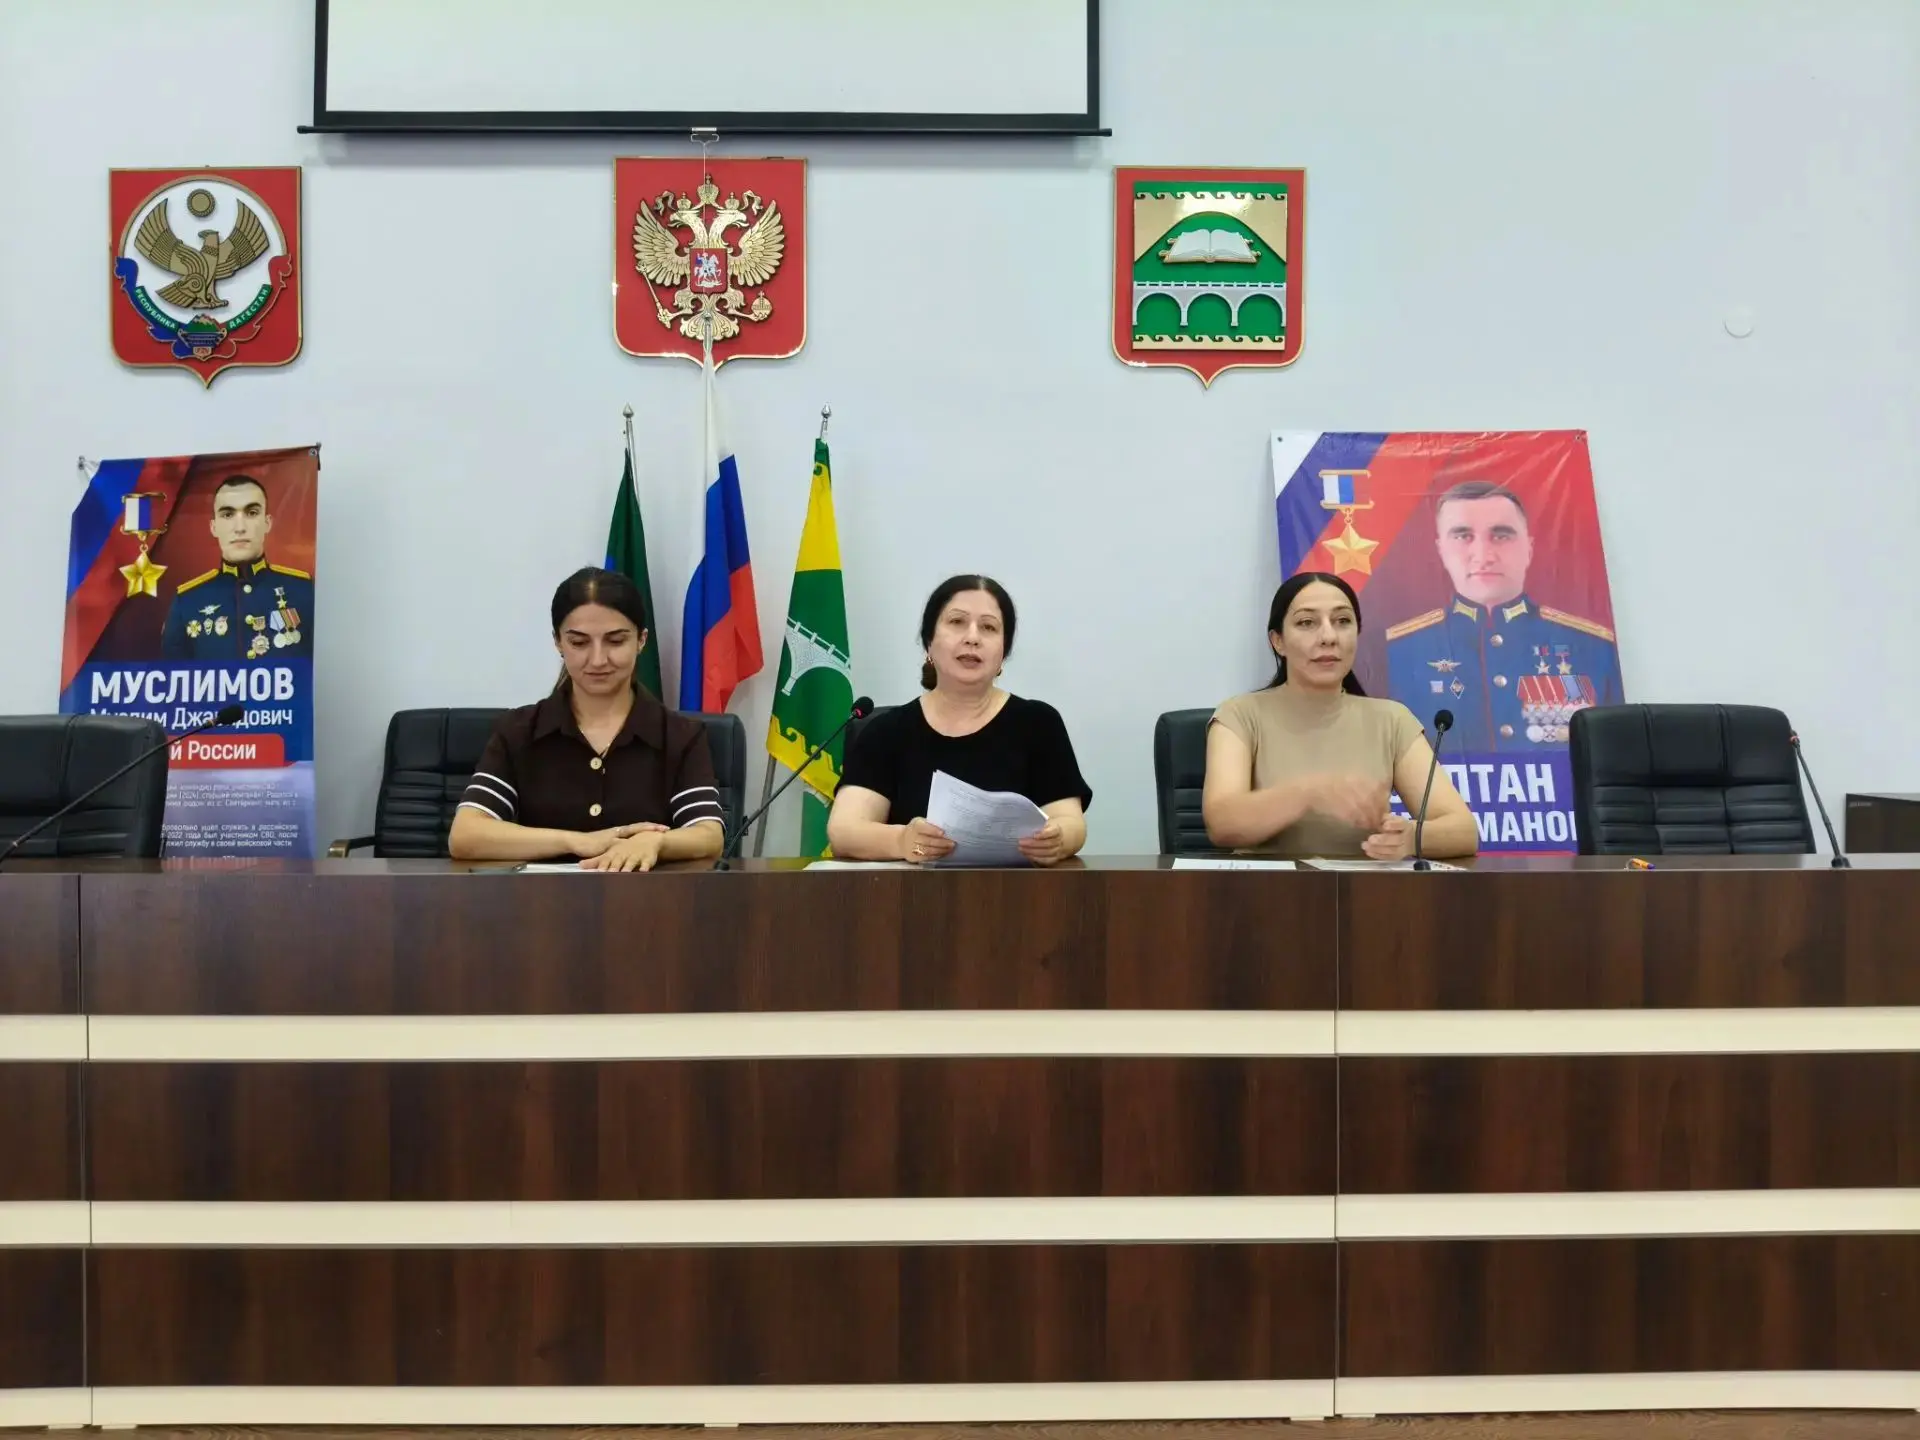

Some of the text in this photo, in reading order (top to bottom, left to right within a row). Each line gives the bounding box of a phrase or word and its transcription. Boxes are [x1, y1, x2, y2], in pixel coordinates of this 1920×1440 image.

[229, 288, 270, 329] ДАГЕСТАН
[91, 667, 294, 704] МУСЛИМОВ
[171, 707, 293, 729] Джадович
[188, 740, 257, 760] России
[1438, 763, 1556, 803] ЛТАН
[1474, 811, 1577, 842] МАНО
